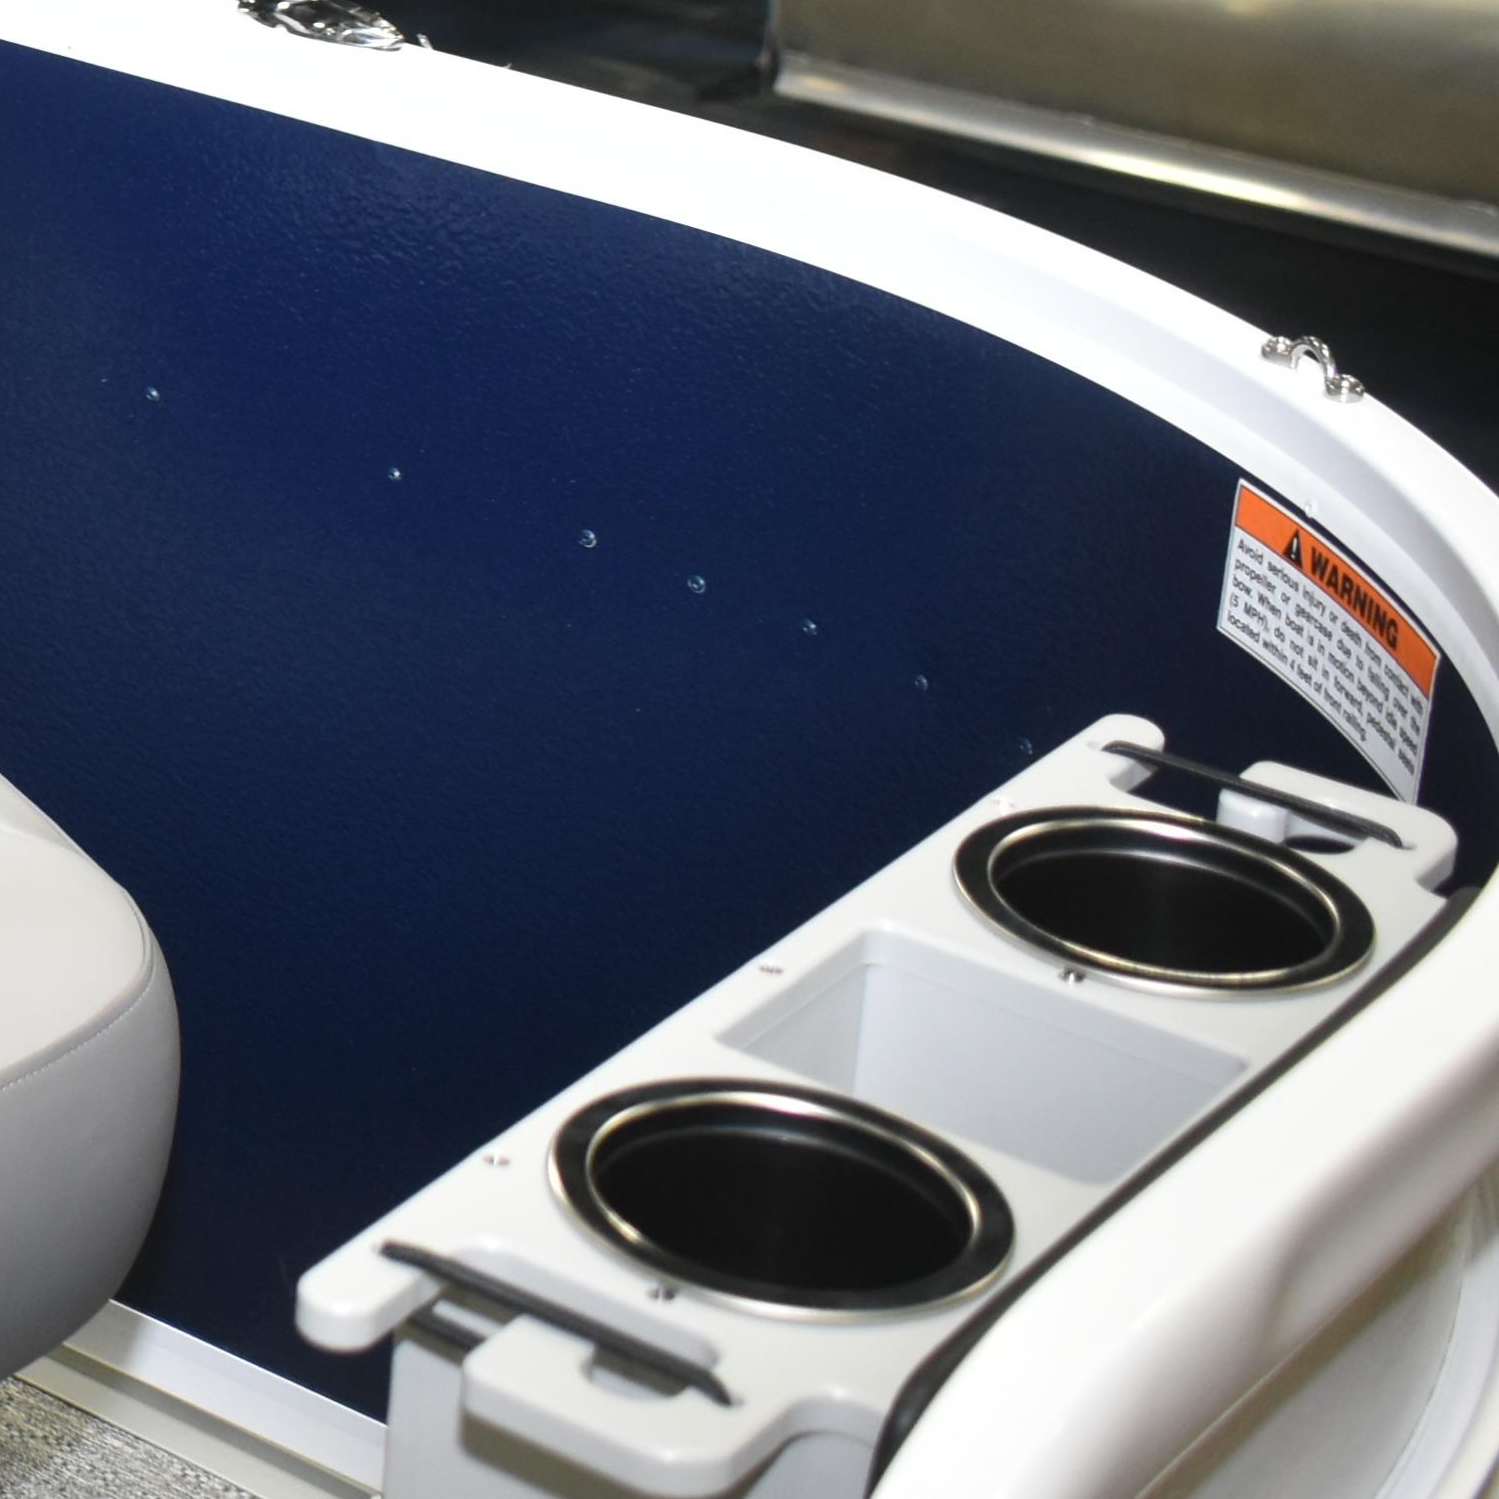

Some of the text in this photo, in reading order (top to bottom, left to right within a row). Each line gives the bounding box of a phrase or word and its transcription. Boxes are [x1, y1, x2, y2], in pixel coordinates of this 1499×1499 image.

[1227, 611, 1261, 643] located
[1261, 639, 1288, 665] within
[1296, 663, 1312, 686] feet
[1232, 576, 1253, 597] bow.
[1257, 591, 1282, 618] When
[1285, 614, 1305, 636] boat
[1327, 652, 1355, 683] motion
[1356, 677, 1384, 714] beyond
[1234, 560, 1276, 592] propeller
[1280, 592, 1291, 605] or
[1294, 604, 1333, 641] gearcase
[1336, 639, 1352, 659] due
[1237, 539, 1264, 565] Avoid
[1267, 563, 1299, 591] serious
[1302, 586, 1326, 616] injury
[1329, 611, 1338, 624] or
[1340, 622, 1362, 648] death
[1364, 642, 1382, 667] from
[1384, 665, 1409, 698] contact
[1273, 627, 1285, 643] do
[1311, 545, 1399, 651] WARNING
